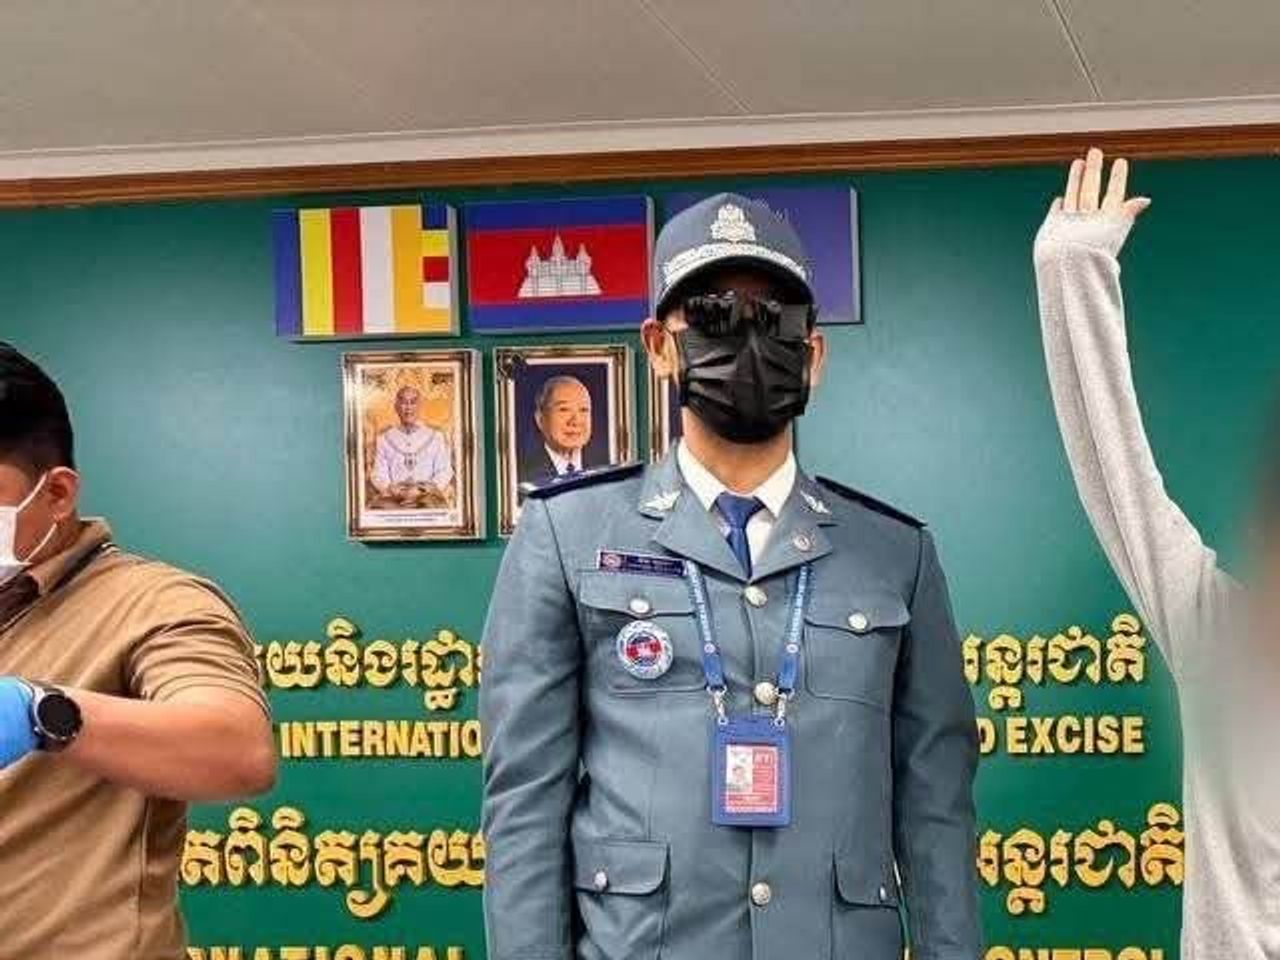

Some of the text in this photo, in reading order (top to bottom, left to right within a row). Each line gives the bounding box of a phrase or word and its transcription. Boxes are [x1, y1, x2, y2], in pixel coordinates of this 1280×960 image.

[255, 617, 482, 710] យនិងរដ្ឋា
[280, 719, 482, 757] INTERNATIO
[1006, 716, 1145, 753] EXCISE
